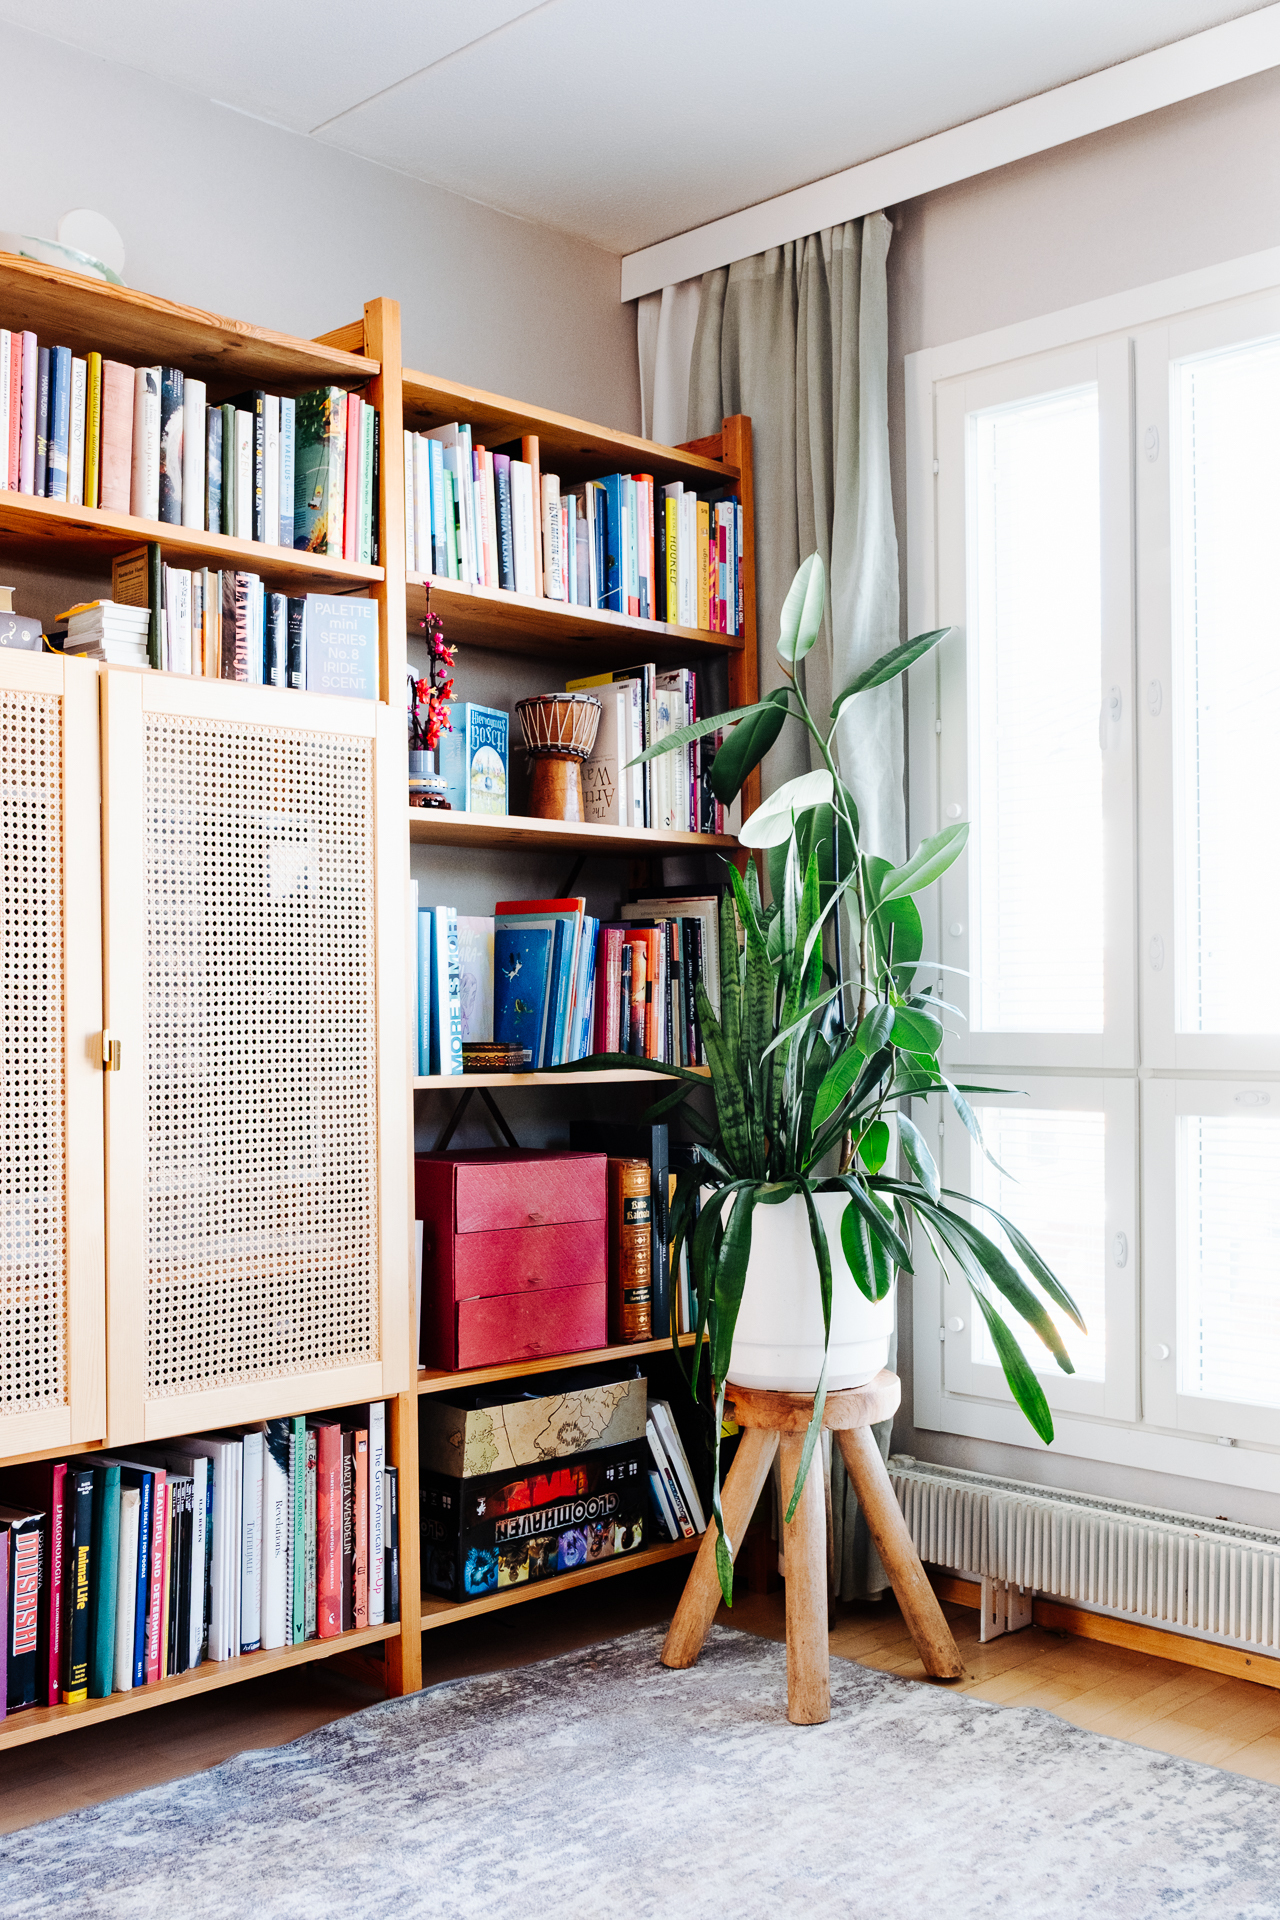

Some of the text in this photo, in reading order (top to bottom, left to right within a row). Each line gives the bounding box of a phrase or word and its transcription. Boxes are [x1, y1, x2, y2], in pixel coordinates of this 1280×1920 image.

[74, 371, 83, 411] WOMEN
[91, 374, 100, 428] MACHIAVELLI
[73, 418, 82, 444] TROY
[73, 453, 81, 491] BARKER
[240, 452, 250, 478] ZEN
[498, 468, 510, 574] KUINKA PUHUA VALASTA
[669, 535, 678, 586] HOOKED
[700, 548, 708, 586] co-design
[315, 602, 371, 618] PALETTE
[329, 618, 359, 630] mini
[320, 632, 367, 647] SERIES
[321, 676, 367, 690] SCENT.
[323, 662, 365, 675] IRIDE-
[470, 725, 506, 753] BOSCH
[592, 806, 606, 819] The
[446, 907, 461, 975] MORE
[450, 1006, 463, 1075] MORE
[296, 1453, 304, 1485] NECESSITY
[275, 1500, 285, 1559] Revelations.
[296, 1495, 304, 1536] GARDENING
[343, 1498, 353, 1556] WENDELIN
[372, 1446, 384, 1595] The Great American Pin-Up
[495, 1492, 620, 1543] GLOOMHAVEN
[37, 1529, 45, 1590] YOSHIKAWA
[54, 1504, 63, 1587] DRAGONOLOGIA
[246, 1521, 256, 1576] TAITEILIJALLE
[13, 1530, 40, 1657] MUSASHI
[76, 1545, 91, 1610] Animal Life
[150, 1483, 165, 1660] BEAUTIFUL AND DETERMINED
